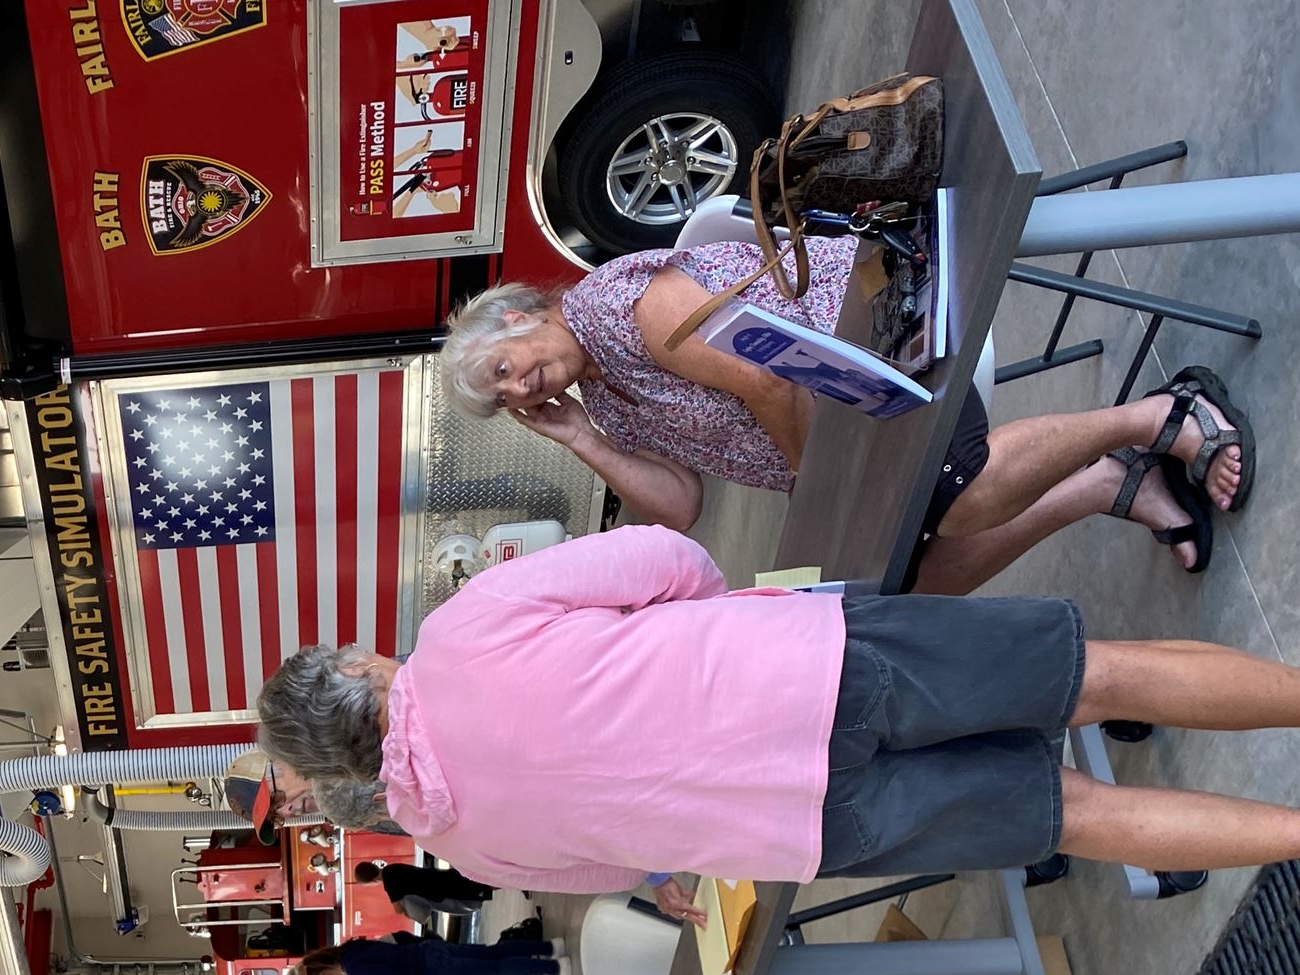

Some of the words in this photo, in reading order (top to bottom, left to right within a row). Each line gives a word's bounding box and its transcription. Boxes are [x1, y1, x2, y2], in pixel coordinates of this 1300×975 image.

[452, 81, 467, 108] FIRE
[359, 103, 368, 142] Extinguisher
[369, 101, 385, 156] Method
[370, 159, 384, 194] PASS
[93, 171, 127, 250] BATH
[148, 180, 168, 234] BATH
[167, 213, 175, 228] FIRE
[177, 195, 186, 214] OHIO
[34, 384, 94, 568] SIMULATOR
[63, 573, 110, 674] SAFETY
[82, 681, 118, 736] FIRE
